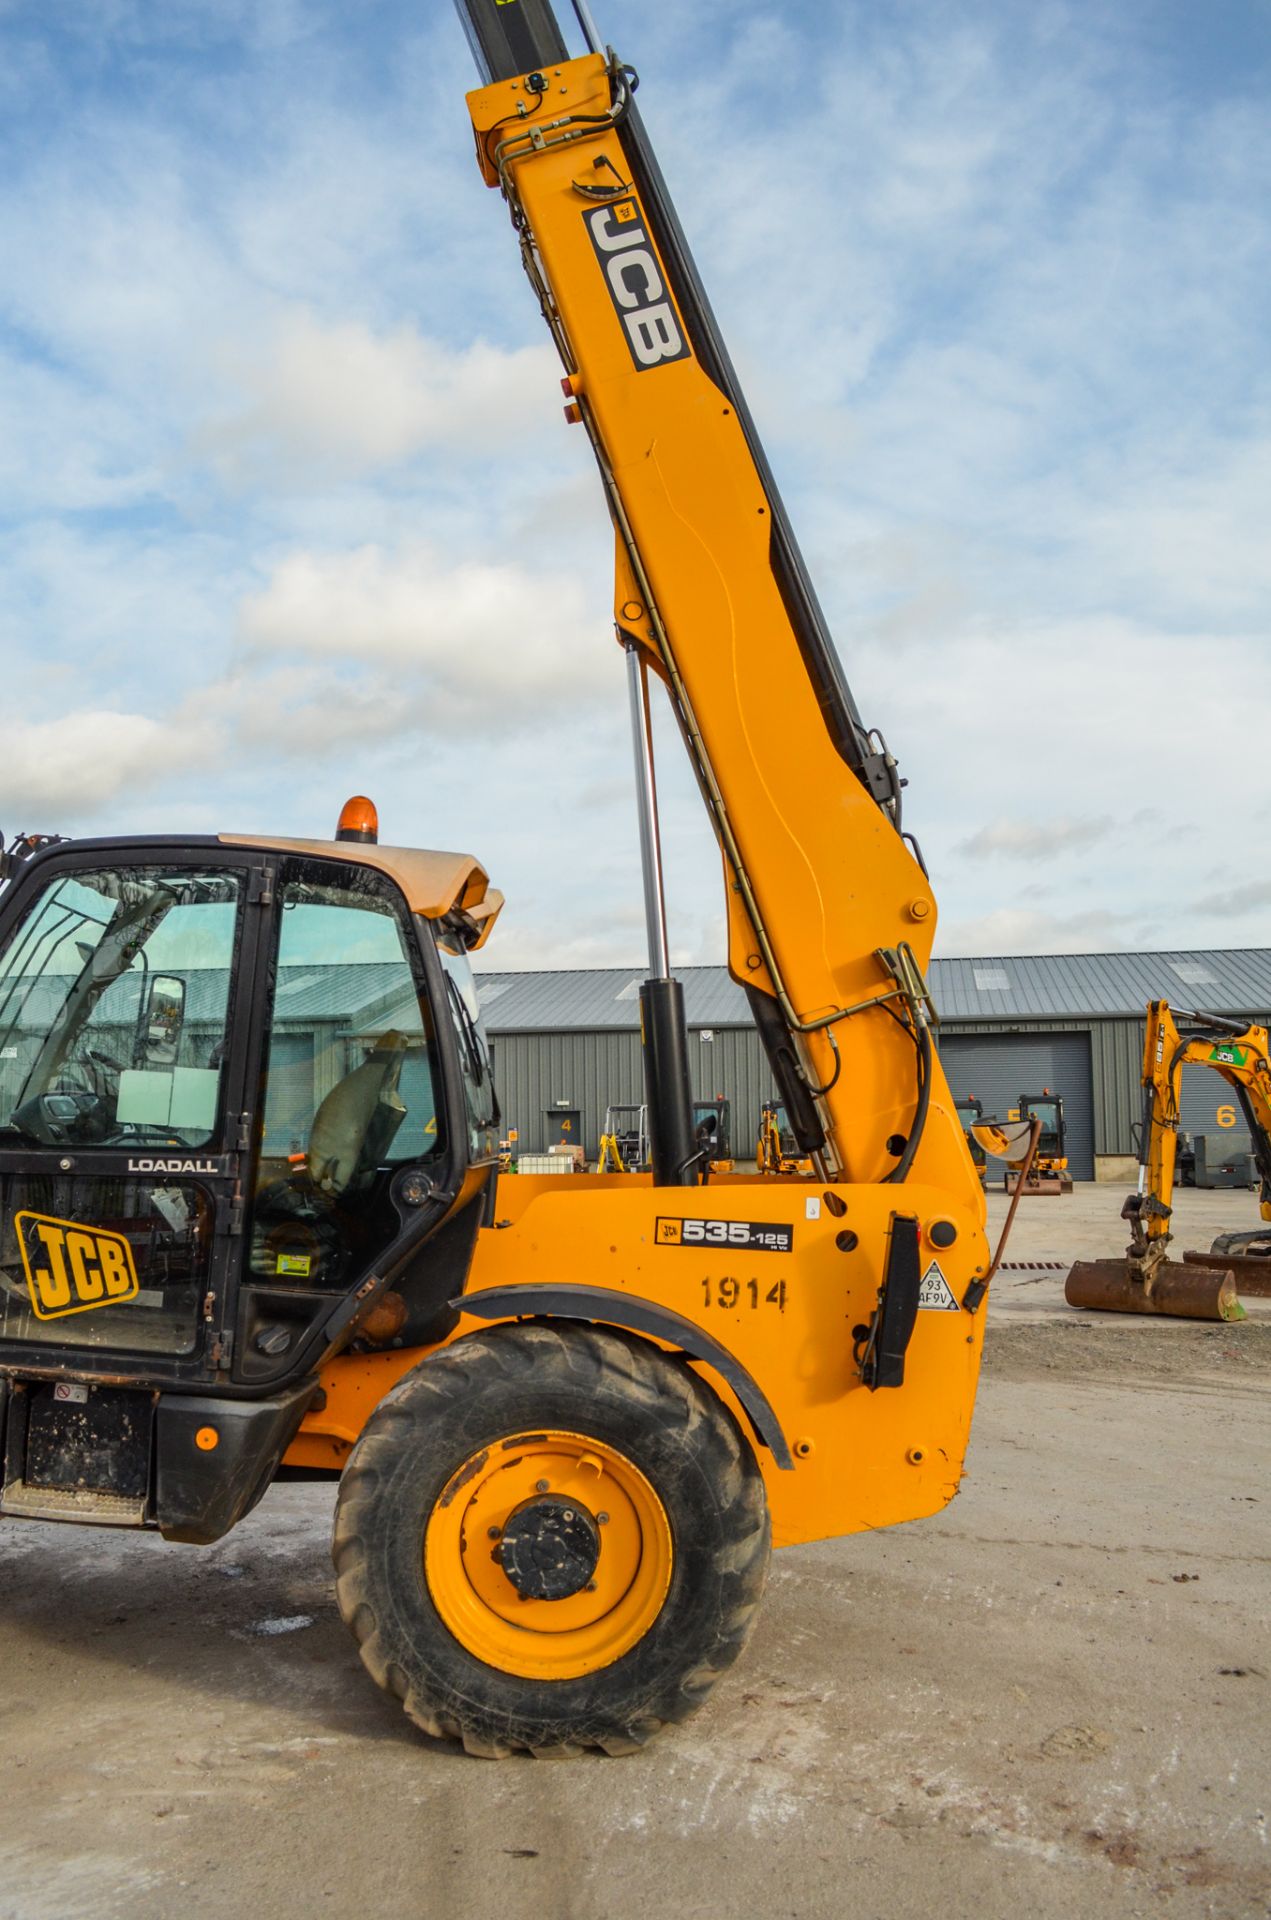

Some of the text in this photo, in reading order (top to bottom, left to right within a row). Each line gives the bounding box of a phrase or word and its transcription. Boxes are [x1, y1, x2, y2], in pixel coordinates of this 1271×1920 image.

[590, 208, 682, 365] JCB
[1217, 1051, 1234, 1063] JCB
[561, 1119, 571, 1132] 4
[1216, 1105, 1237, 1128] 6
[128, 1158, 218, 1173] LOADALL
[682, 1220, 788, 1245] 535-125
[35, 1224, 130, 1308] JCB
[701, 1276, 787, 1311] 1914
[927, 1280, 941, 1291] 93
